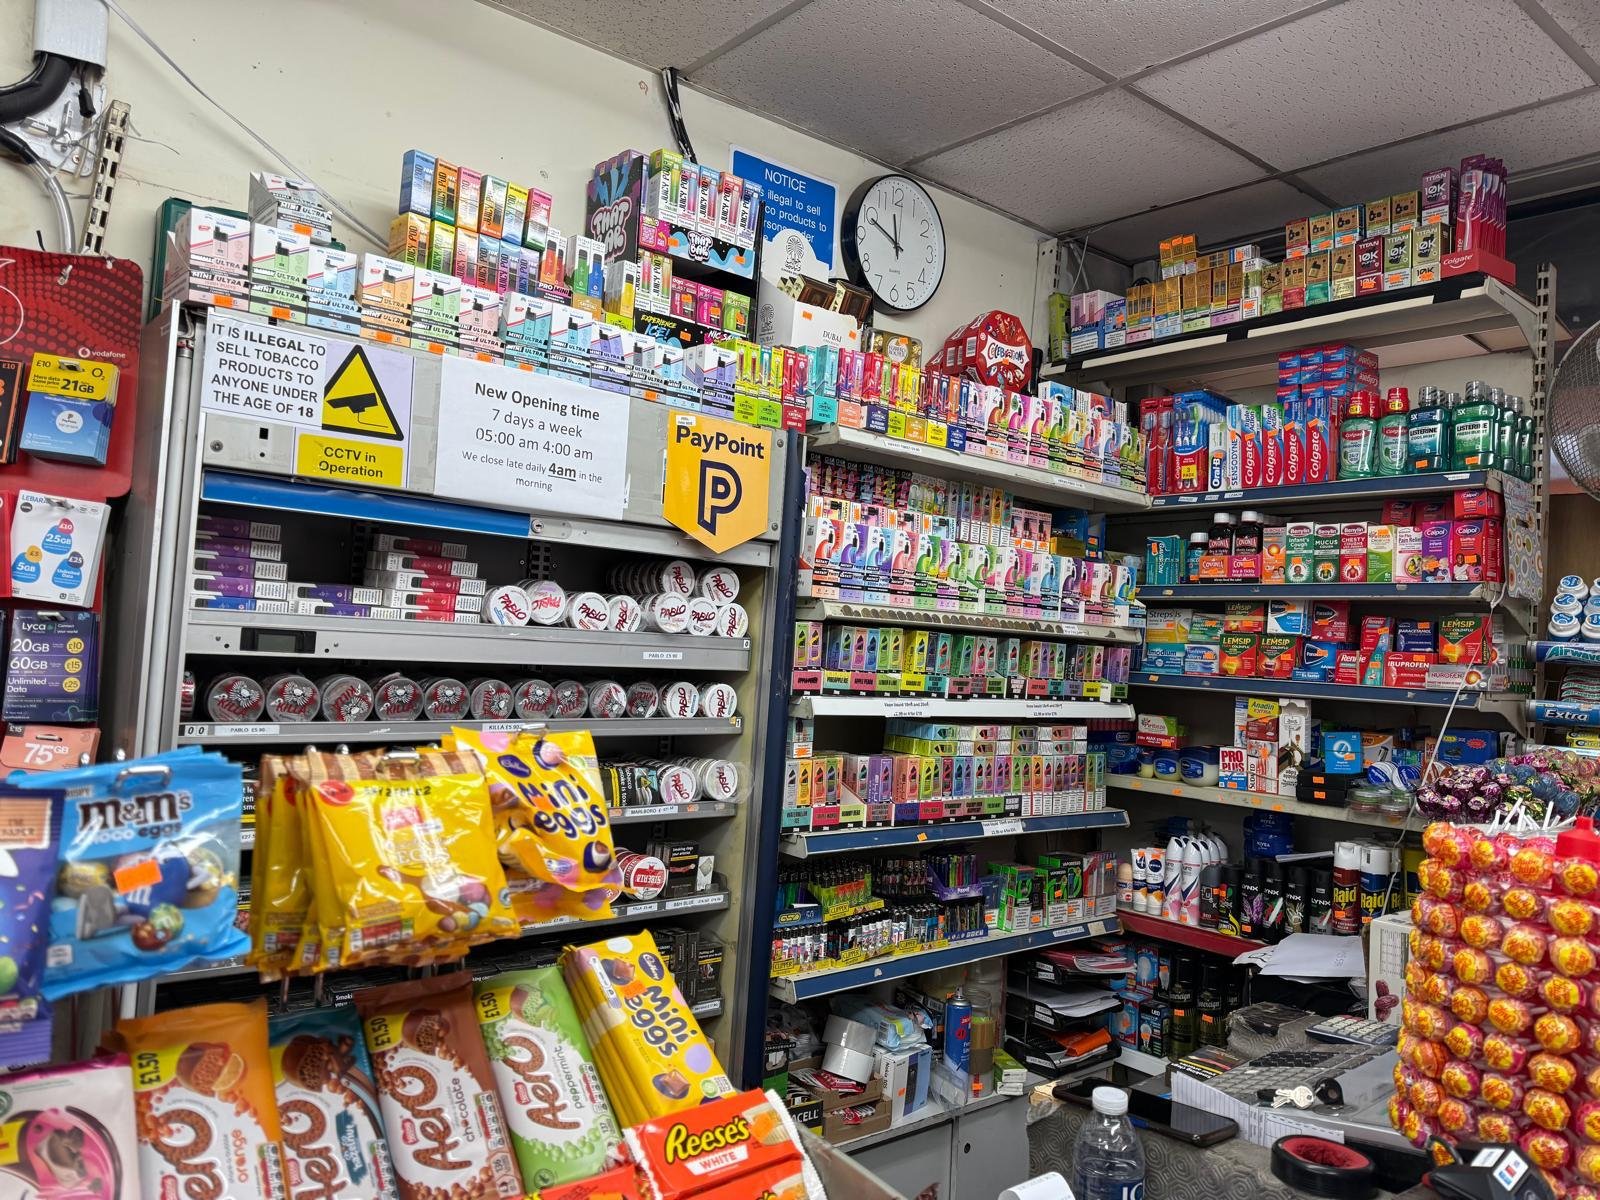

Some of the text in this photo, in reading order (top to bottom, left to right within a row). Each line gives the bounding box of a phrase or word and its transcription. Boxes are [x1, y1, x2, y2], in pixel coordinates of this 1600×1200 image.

[765, 168, 806, 194] NOTICE
[1424, 172, 1447, 182] TITAN
[892, 186, 904, 208] 12
[1425, 182, 1445, 196] 10K
[768, 189, 792, 206] illegal
[796, 199, 804, 210] to
[806, 202, 821, 216] sell
[877, 189, 888, 211] 11
[912, 199, 916, 218] 1
[592, 200, 629, 234] THAT
[779, 209, 816, 228] products
[819, 222, 827, 232] to
[863, 204, 878, 225] 10
[857, 226, 866, 245] 9
[920, 219, 930, 238] 2
[1416, 227, 1438, 237] TITAN
[690, 233, 711, 247] THAT
[1358, 240, 1379, 249] TITAN
[1386, 234, 1408, 244] TITAN
[1415, 238, 1436, 251] 10K
[925, 245, 934, 264] 3
[1358, 250, 1378, 262] 10K
[1386, 246, 1406, 257] 10K
[1443, 253, 1473, 266] Colgate
[862, 252, 871, 272] 8
[216, 276, 241, 286] ULTRA
[874, 274, 883, 292] 7
[918, 267, 927, 285] 4
[276, 289, 300, 300] ULTRA
[890, 283, 899, 303] 6
[906, 281, 916, 301] 5
[332, 301, 355, 312] ULTRA
[433, 311, 453, 320] ULTRA
[640, 314, 677, 328] EXPERIENCE
[212, 324, 326, 356] IT IS ILLEGAL TO
[433, 326, 453, 336] ULTRA
[473, 326, 492, 336] ULTRA
[822, 330, 842, 343] DUBAI
[479, 337, 498, 347] ULTRA
[36, 359, 51, 368] £10
[216, 342, 319, 370] SELL TOBACCO
[219, 358, 314, 385] PRODUCTS TO
[60, 379, 94, 393] 21GB
[211, 374, 318, 403] ANYONE UNDER
[213, 391, 314, 418] THE AGE OF 18
[475, 382, 600, 421] New Opening time
[493, 409, 583, 438] 7 days a week
[1410, 427, 1438, 436] LISTERINE
[1456, 422, 1488, 431] LISTERINE
[476, 427, 593, 460] 05:00 am 4:00 am
[676, 424, 764, 459] PayPoint
[324, 446, 376, 463] CCTV in
[1244, 439, 1254, 484] Colgate
[1266, 438, 1275, 483] Colgate
[1287, 434, 1297, 481] Colgate
[1310, 431, 1320, 479] Colgate
[319, 461, 383, 479] Operation
[462, 451, 603, 483] We close late daily 4am in the
[1212, 458, 1221, 486] Oral-B
[516, 477, 553, 492] morning
[46, 534, 72, 545] 25GB
[1425, 528, 1447, 538] Calpol
[1457, 526, 1478, 535] Calpol
[17, 562, 35, 572] 5GB
[672, 566, 689, 593] PABLO
[711, 573, 734, 598] PABLO
[499, 593, 527, 620] PABLO
[578, 603, 607, 622] PABLO
[659, 604, 686, 618] PABLO
[691, 610, 716, 623] PABLO
[726, 607, 737, 637] PABLO
[1442, 620, 1475, 628] LEMSIP
[22, 623, 46, 633] Lyca
[12, 638, 50, 652] 20GB
[1222, 637, 1251, 645] LEMSIP
[10, 657, 48, 670] 60GB
[7, 685, 28, 693] Data
[8, 677, 47, 685] Unlimited
[217, 701, 247, 716] KILLA
[276, 702, 307, 715] KILLA
[386, 702, 415, 715] KILLA
[432, 703, 460, 715] KILLA
[523, 700, 548, 713] KILLA
[678, 687, 686, 718] PABLO
[1252, 701, 1274, 710] Anadin
[1545, 709, 1588, 721] Extra
[1221, 750, 1243, 762] PRO
[1222, 763, 1245, 772] PLUS
[672, 773, 689, 799] PABLO
[716, 766, 731, 793] PABLO
[519, 775, 589, 809] Mini
[534, 805, 605, 837] eggs
[637, 874, 661, 883] SIBERIA
[1334, 887, 1357, 902] Raid
[1361, 893, 1384, 908] Raid
[830, 905, 848, 913] CLIPPER
[643, 954, 660, 978] Cadbury
[482, 992, 500, 1023] £1.50
[643, 984, 698, 1041] Mini
[375, 1016, 391, 1047] £1.50
[624, 996, 678, 1058] eggs
[139, 1052, 160, 1085] £1.50
[552, 1045, 584, 1109] peppermint
[505, 1034, 580, 1129] Aero
[452, 1076, 475, 1142] chocolate
[391, 1065, 472, 1172] Aero
[665, 1116, 750, 1163] Reese's
[231, 1128, 248, 1183] orange
[699, 1149, 738, 1171] WHITE
